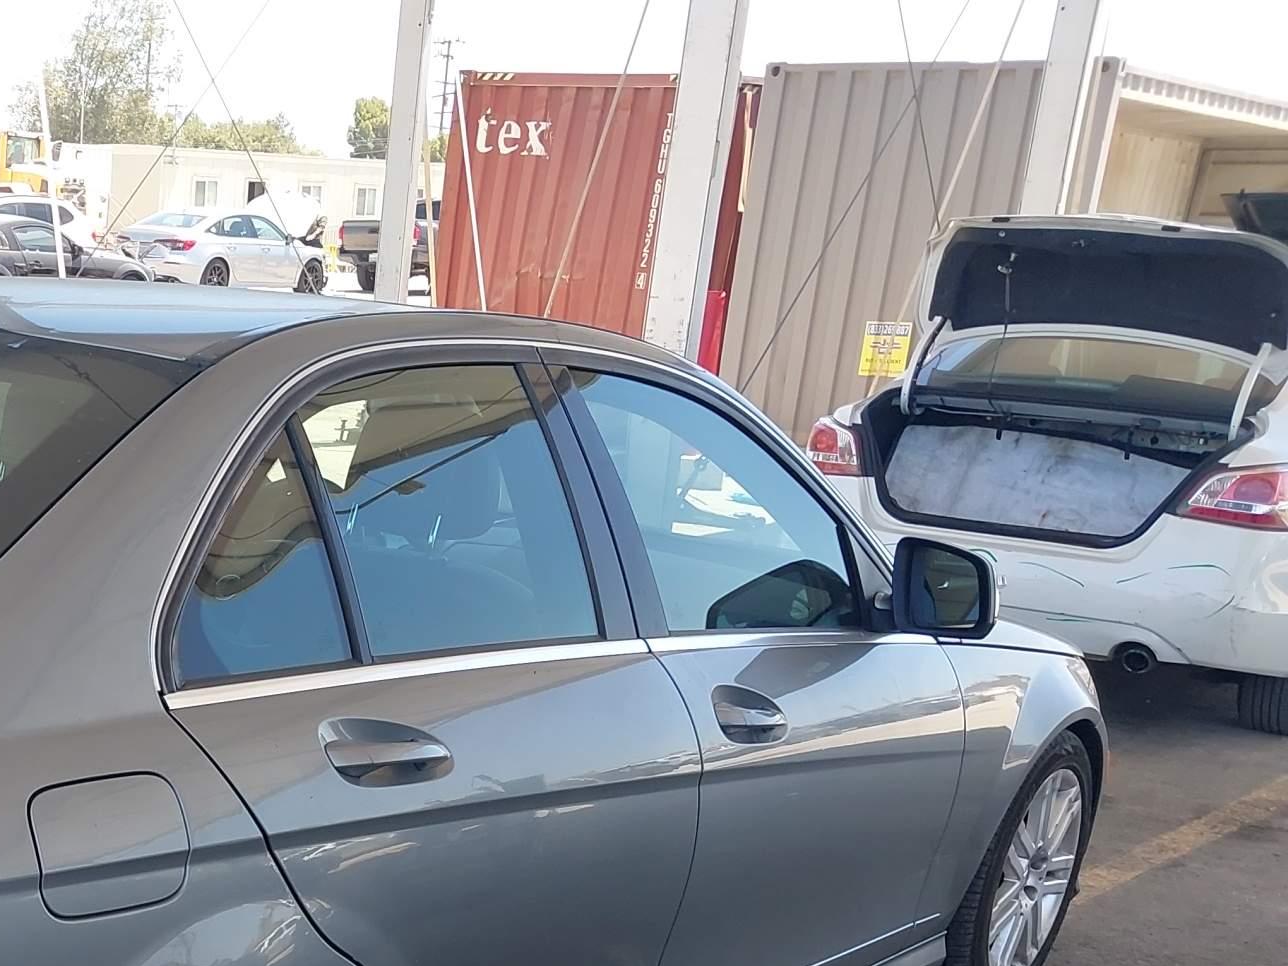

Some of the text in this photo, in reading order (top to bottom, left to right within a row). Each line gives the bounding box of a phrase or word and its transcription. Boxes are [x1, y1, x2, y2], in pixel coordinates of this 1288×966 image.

[476, 107, 551, 157] tex
[636, 112, 673, 289] TGHU 609322 4
